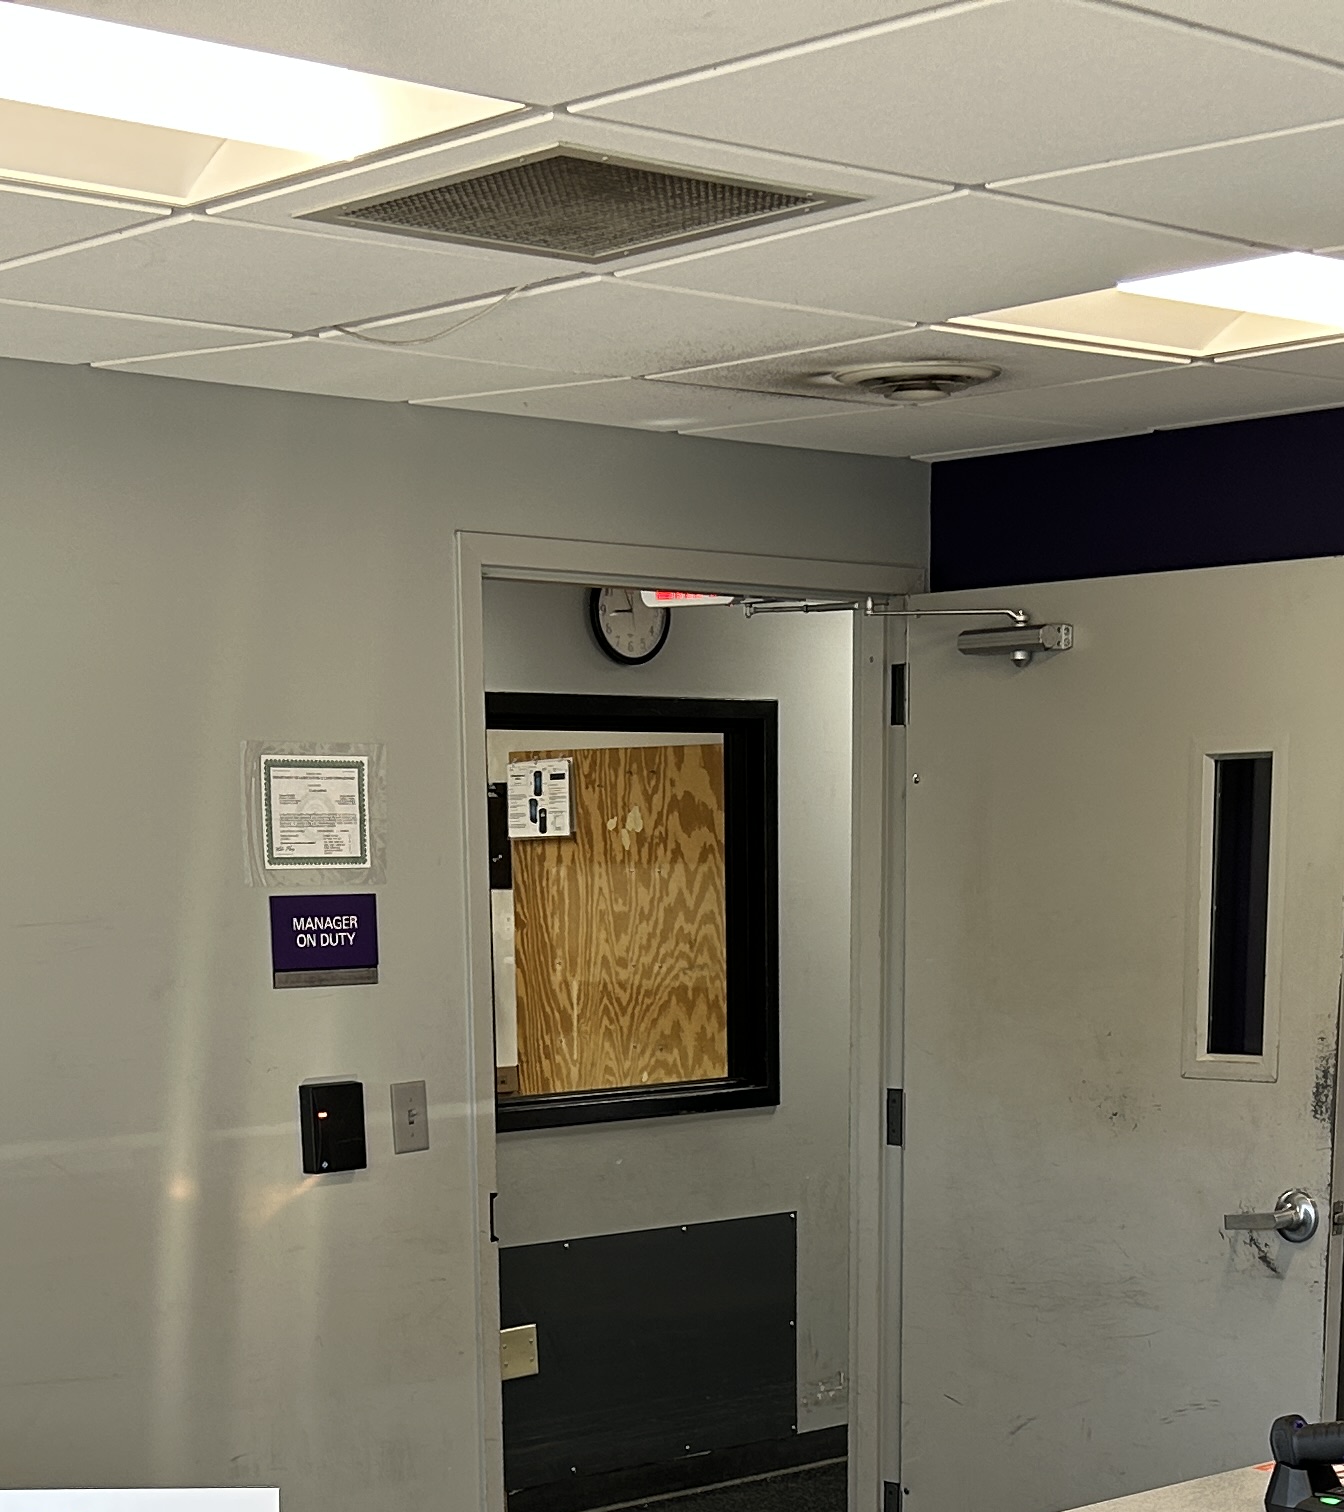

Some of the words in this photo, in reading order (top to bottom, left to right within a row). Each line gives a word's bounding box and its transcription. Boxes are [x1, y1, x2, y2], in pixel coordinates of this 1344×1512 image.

[293, 916, 358, 931] MANAGER
[296, 934, 317, 948] ON
[320, 932, 356, 947] DUTY
